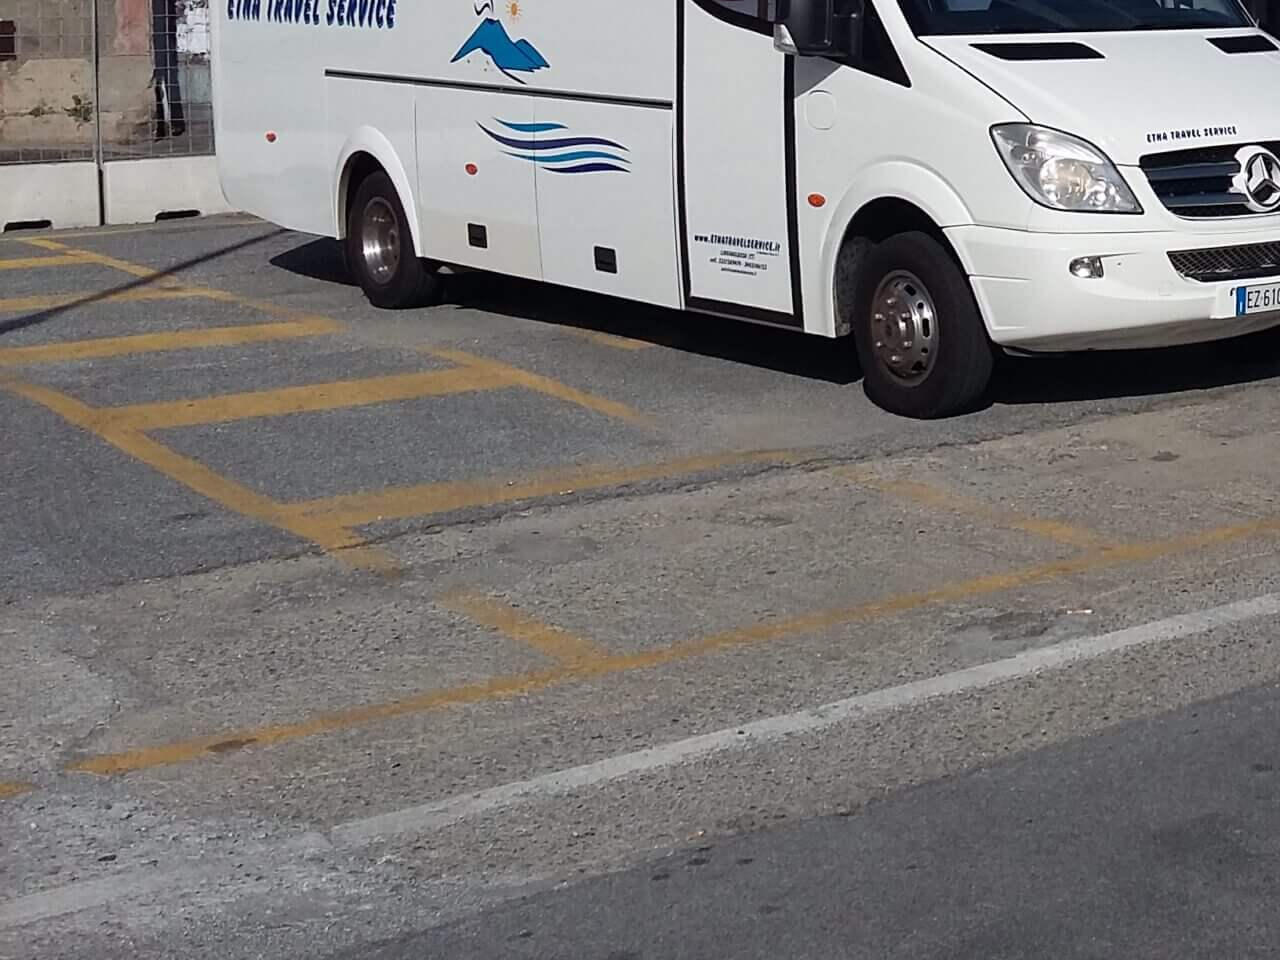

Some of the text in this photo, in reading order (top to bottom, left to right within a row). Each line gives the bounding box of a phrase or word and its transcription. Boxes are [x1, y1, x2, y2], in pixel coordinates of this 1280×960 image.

[1146, 126, 1237, 143] ETNA TRAVEL SERVICE
[1247, 290, 1261, 309] EZ
